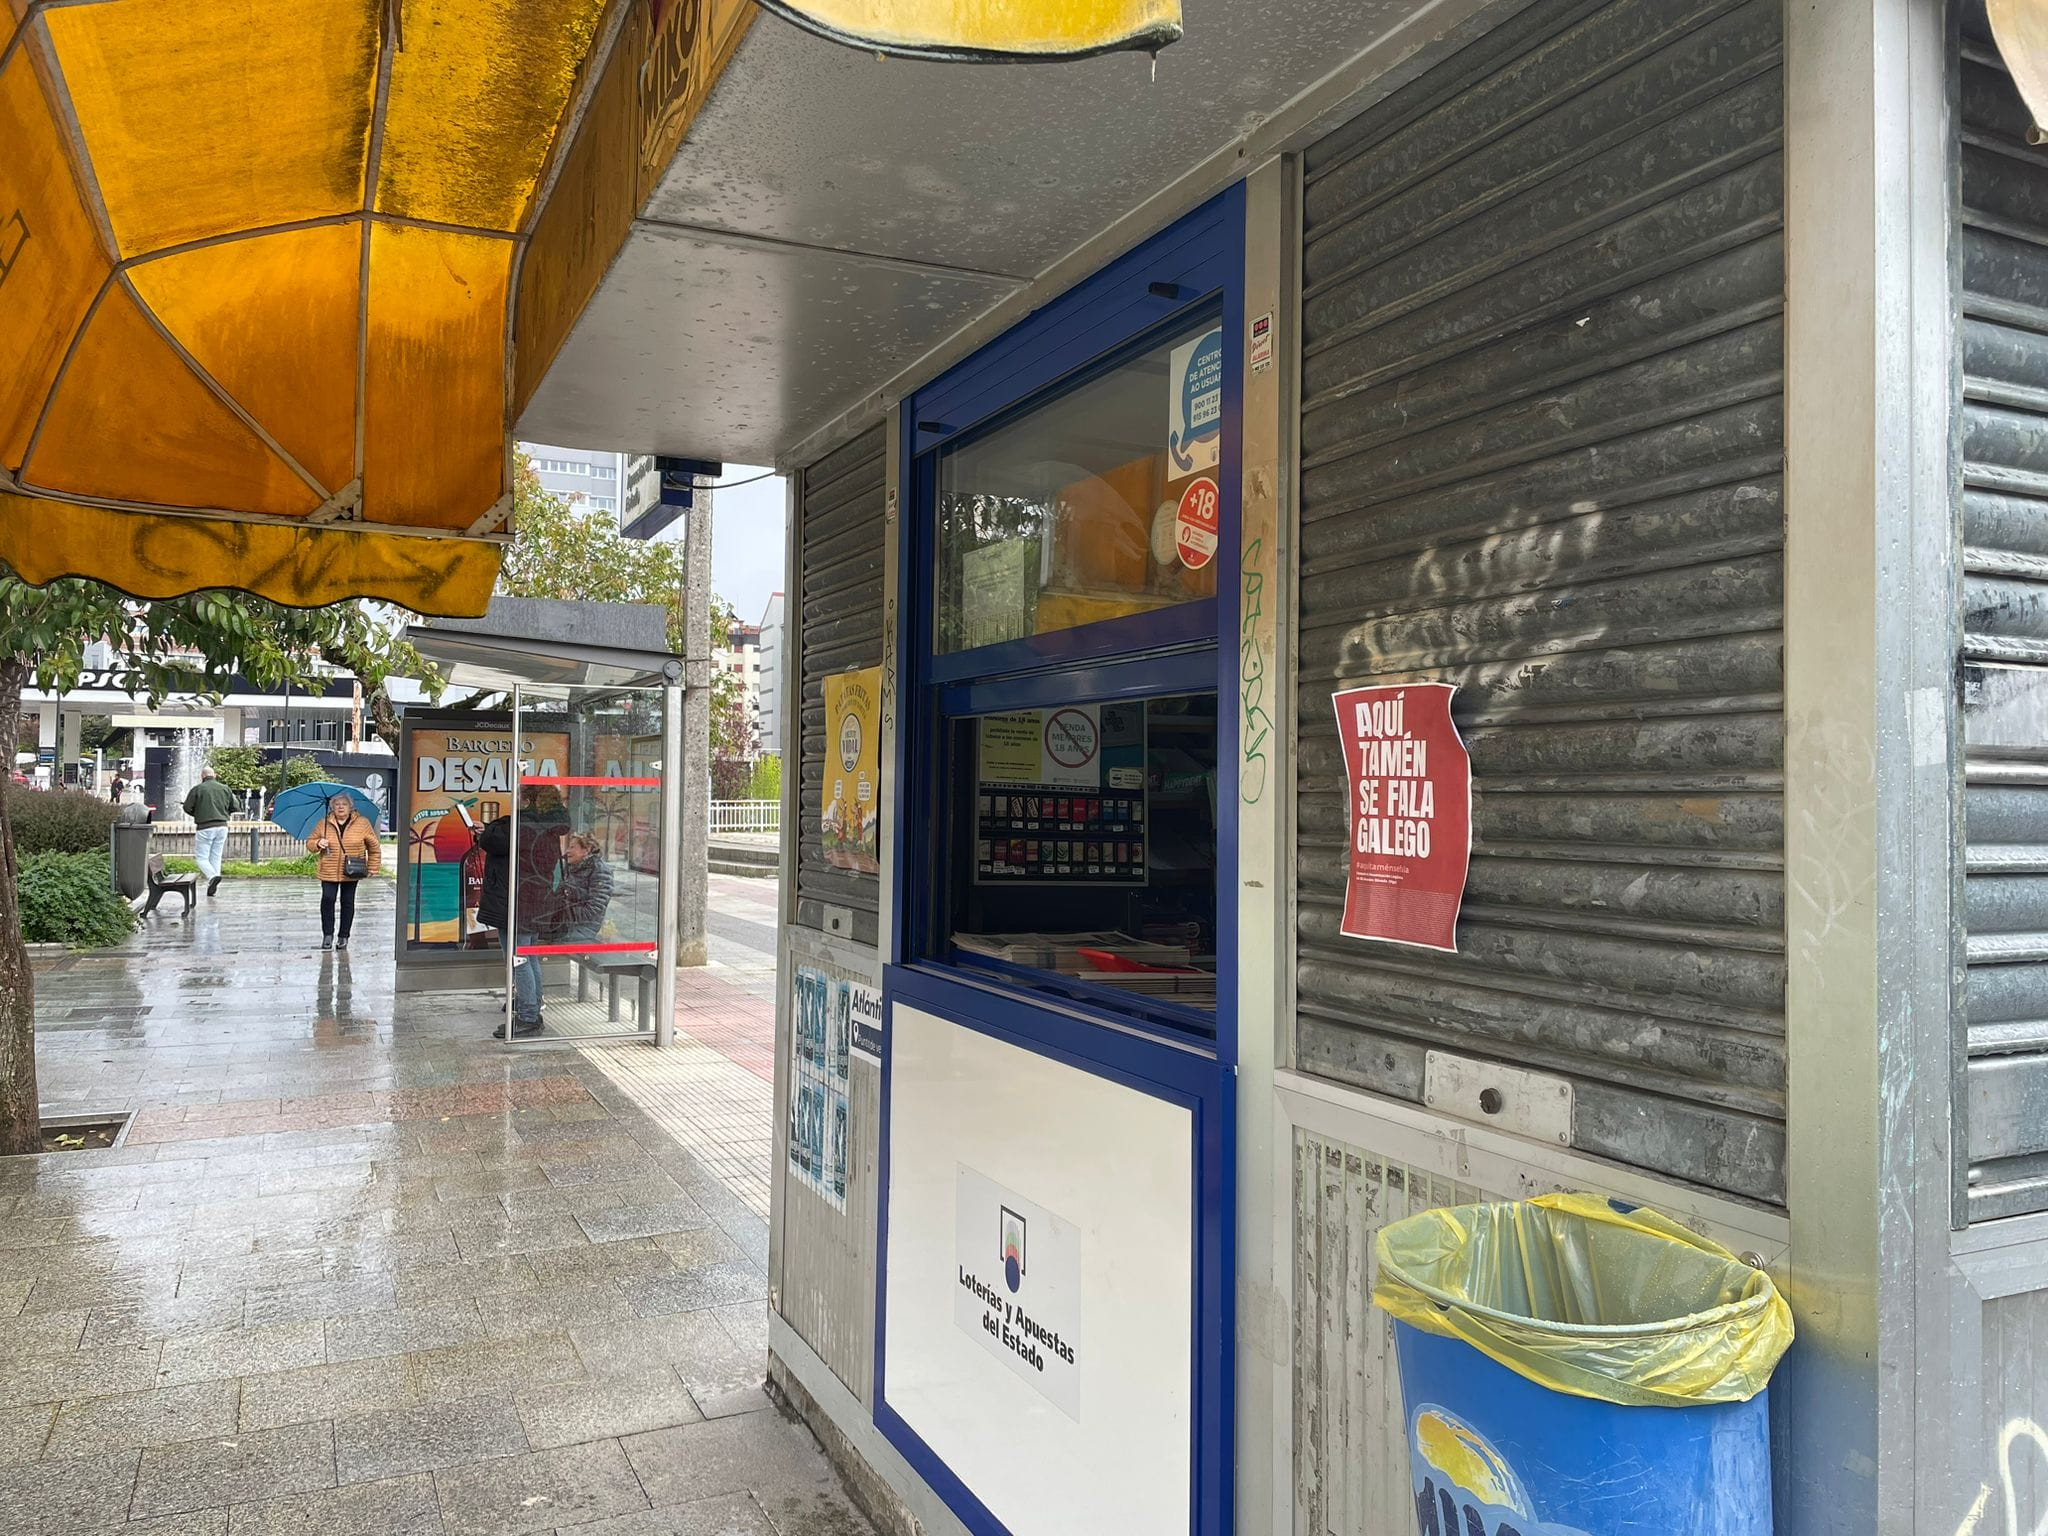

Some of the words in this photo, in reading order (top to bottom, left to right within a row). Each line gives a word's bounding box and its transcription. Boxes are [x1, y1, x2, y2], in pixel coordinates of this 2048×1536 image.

[1189, 372, 1198, 382] DE
[1190, 383, 1200, 393] AO
[1190, 488, 1216, 520] +18
[475, 721, 511, 729] JCDecaux
[1354, 690, 1405, 739] AQUÍ
[1358, 731, 1426, 777] TAMÉN
[1358, 780, 1378, 815] SE
[1387, 780, 1434, 818] FALA
[1356, 817, 1430, 859] GALEGO
[852, 988, 882, 1021] Atlánti
[959, 1264, 1002, 1314] Loterías
[1005, 1301, 1012, 1324] y
[1015, 1305, 1075, 1365] Apuestas
[982, 1310, 999, 1339] del
[1002, 1324, 1044, 1373] Estado
